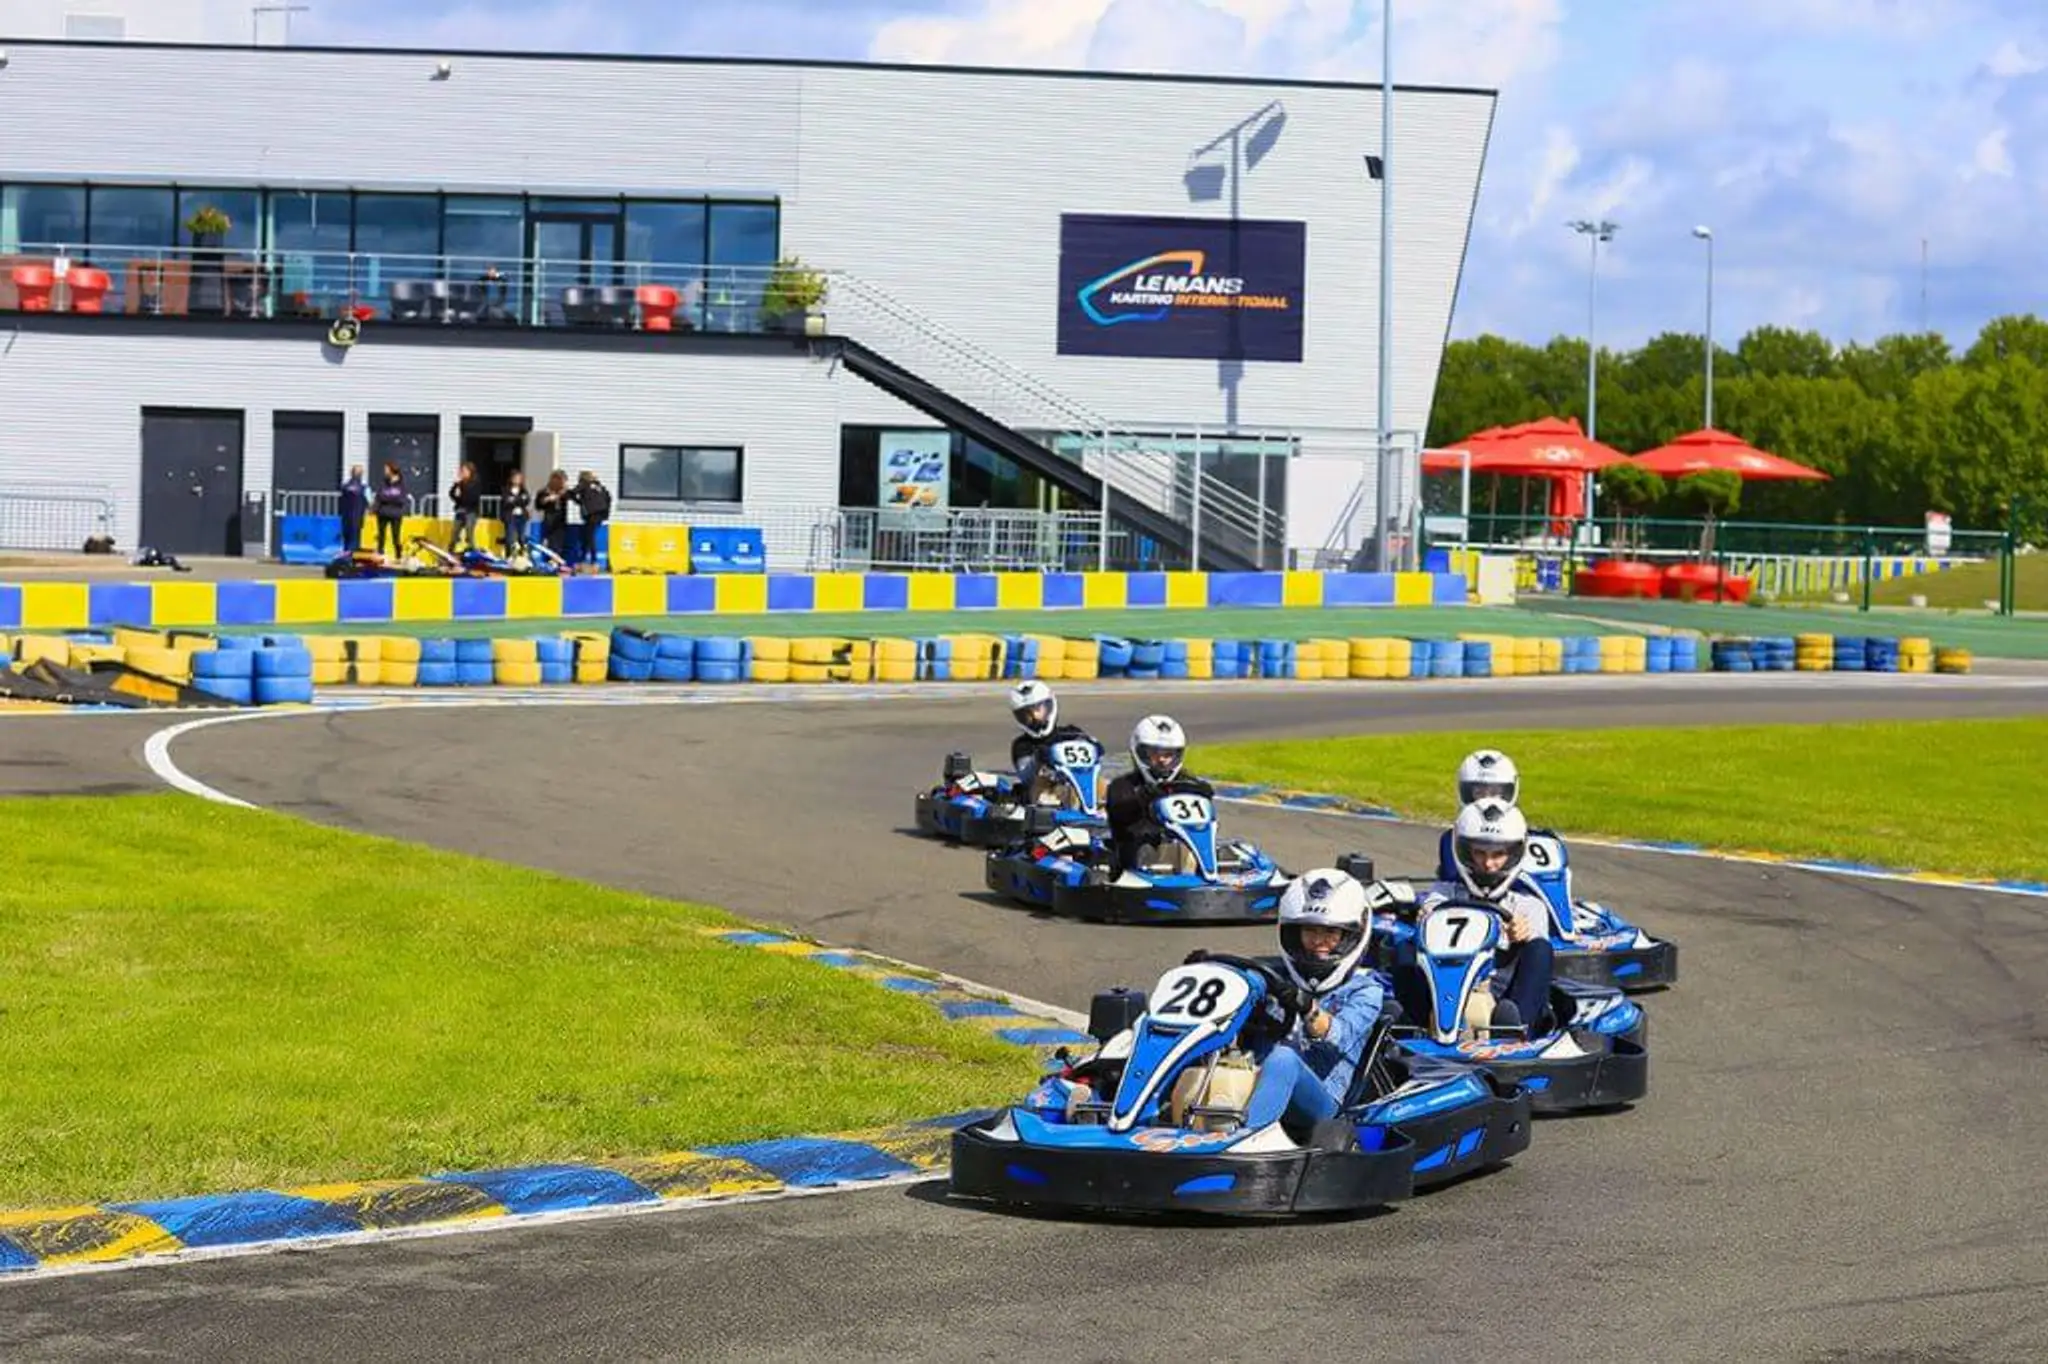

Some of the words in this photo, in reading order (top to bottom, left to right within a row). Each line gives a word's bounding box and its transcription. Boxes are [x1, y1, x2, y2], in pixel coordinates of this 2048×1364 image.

[1164, 276, 1245, 294] MANS
[1110, 292, 1174, 305] KARTING
[1064, 746, 1091, 764] 53
[1172, 799, 1205, 820] 31
[1528, 843, 1550, 866] 9
[1446, 917, 1469, 948] 7
[1157, 976, 1226, 1018] 28
